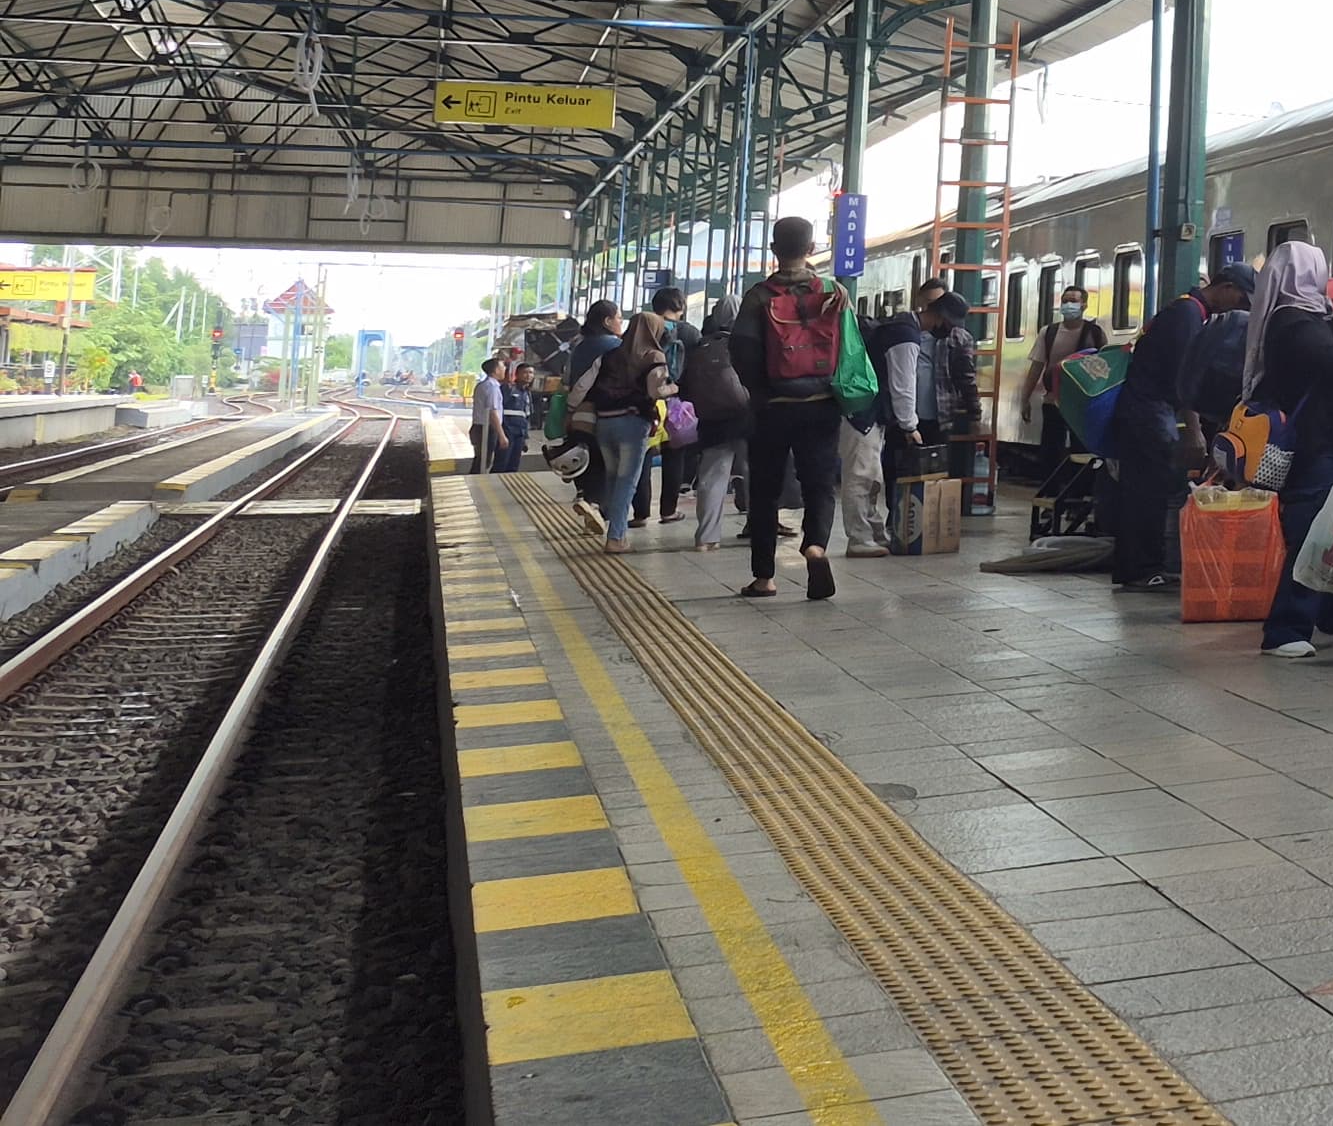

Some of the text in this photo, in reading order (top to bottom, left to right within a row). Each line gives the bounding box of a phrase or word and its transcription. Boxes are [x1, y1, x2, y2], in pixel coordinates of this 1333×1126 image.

[504, 91, 592, 107] Pintu Keluar
[504, 107, 522, 115] Exit
[845, 197, 859, 269] MADIUN
